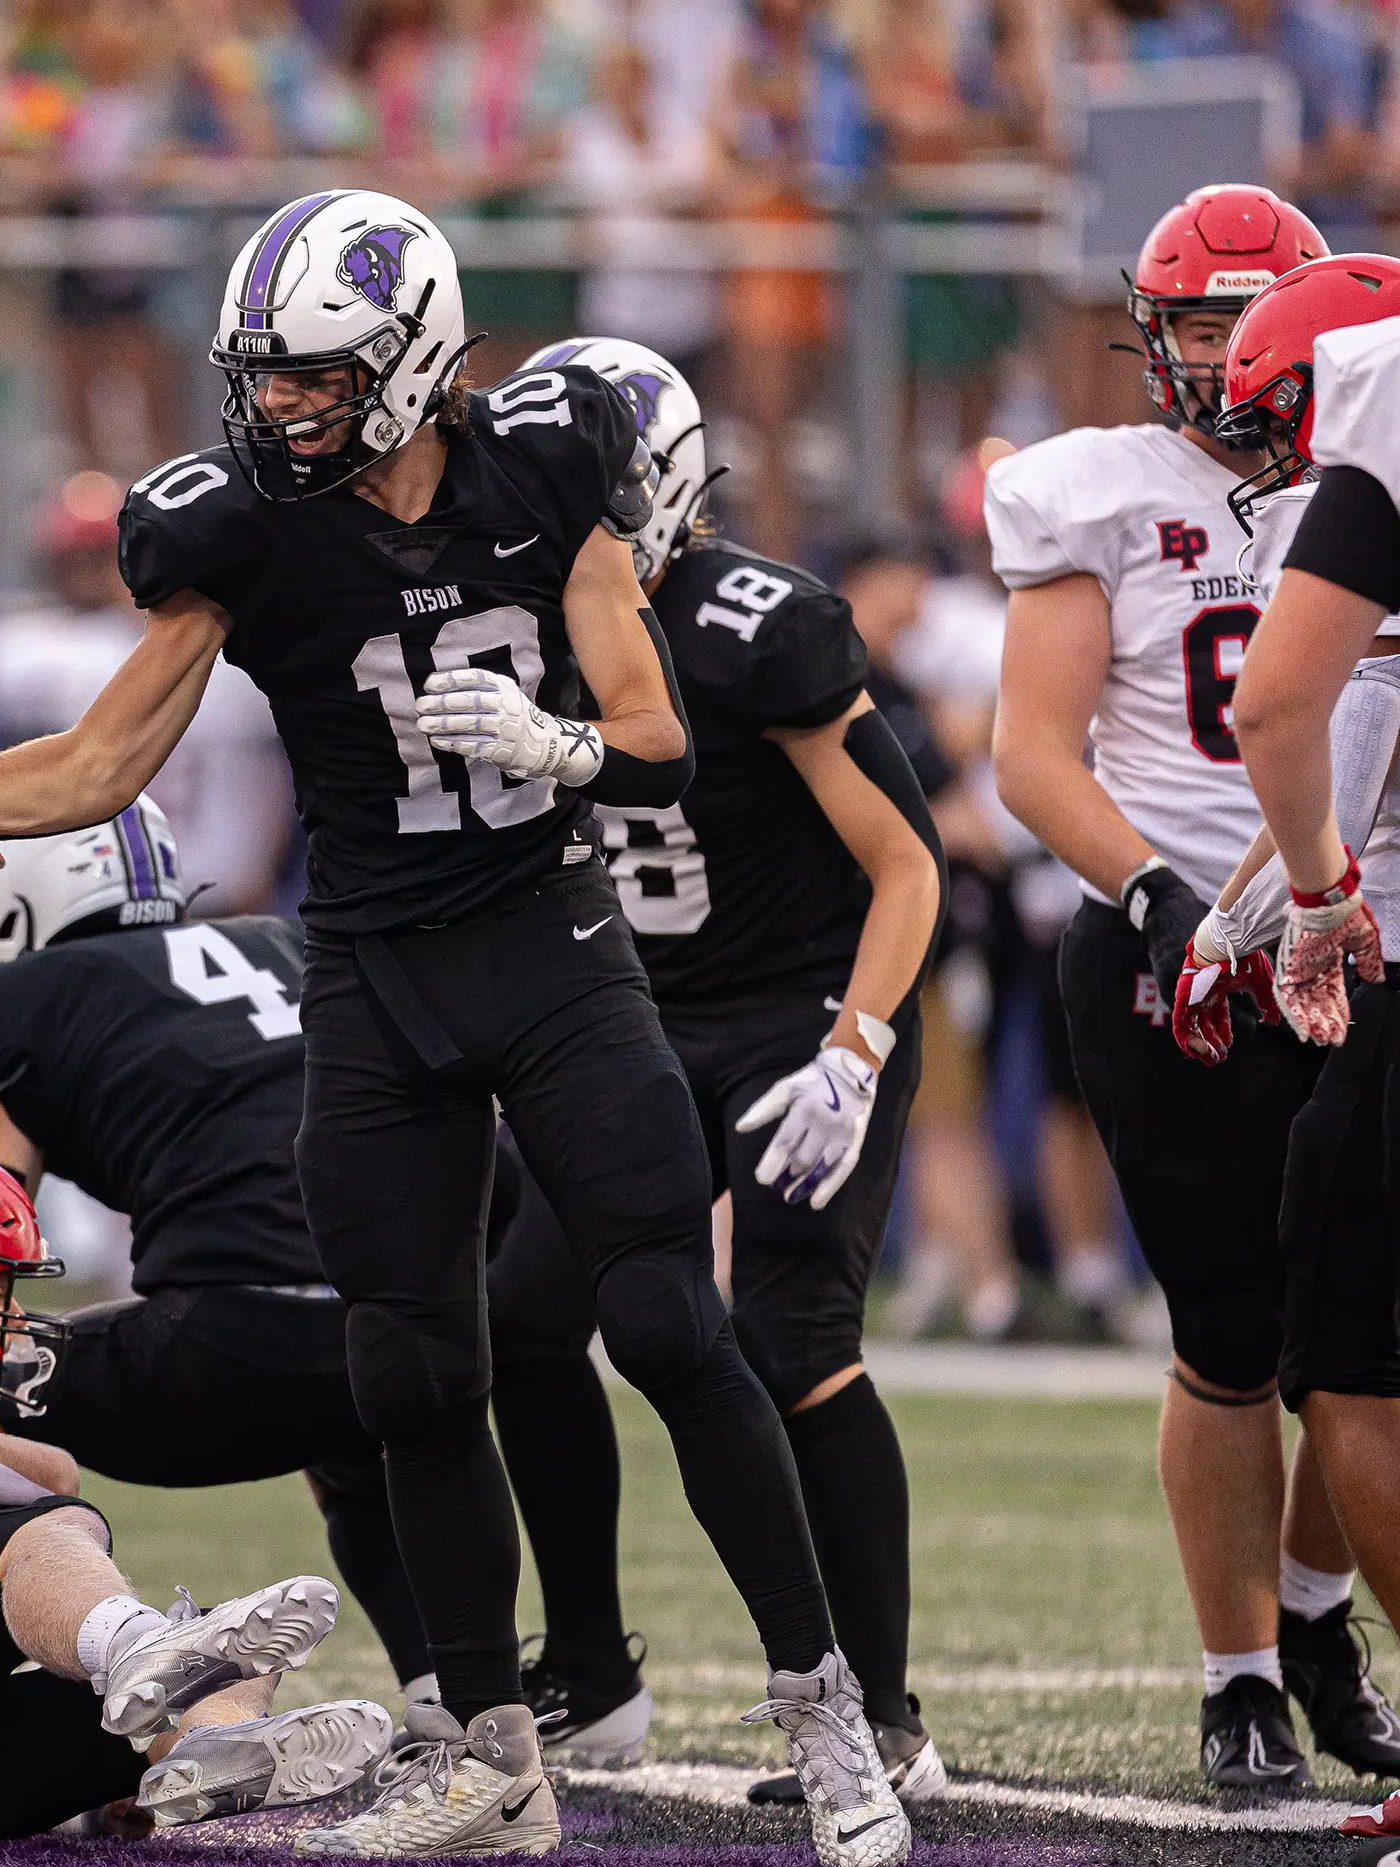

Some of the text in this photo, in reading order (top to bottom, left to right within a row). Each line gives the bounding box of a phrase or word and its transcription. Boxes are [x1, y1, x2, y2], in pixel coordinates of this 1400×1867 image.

[486, 370, 573, 436] 10
[129, 452, 230, 511] 10
[1154, 518, 1210, 573] EP
[400, 584, 463, 617] BISON
[695, 565, 794, 643] 18
[119, 899, 177, 926] BISON
[163, 923, 303, 1041] 4
